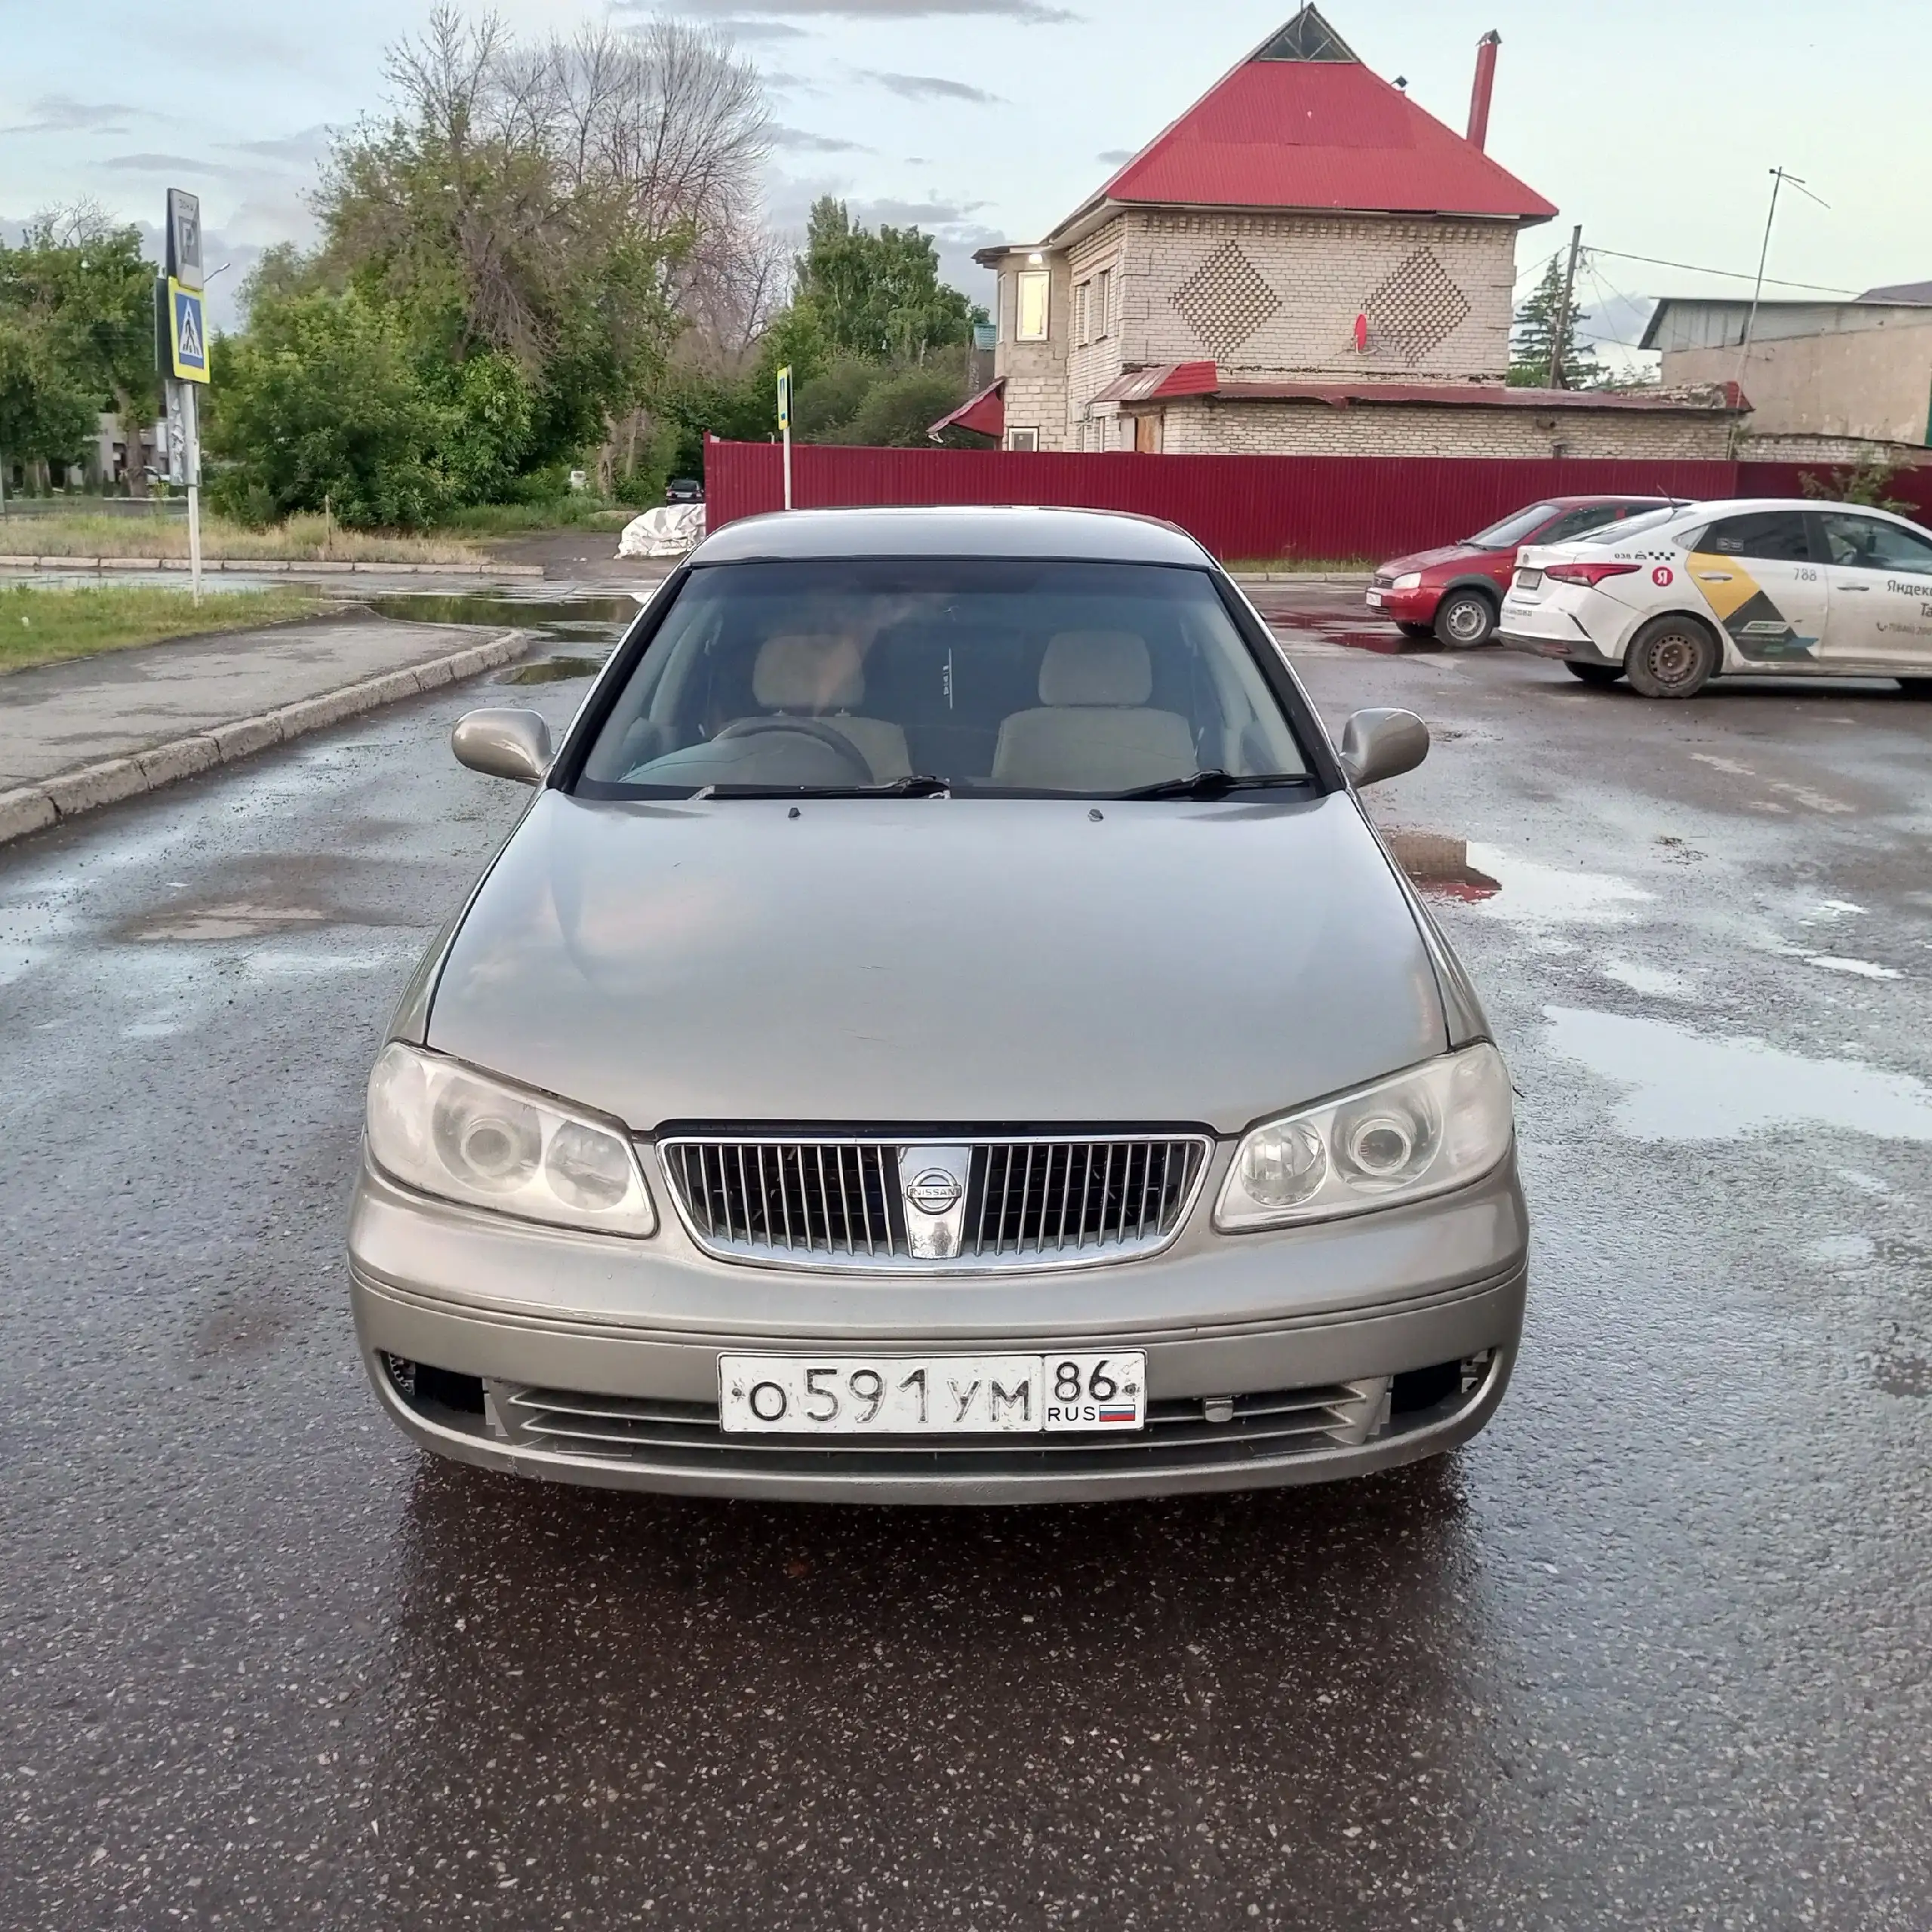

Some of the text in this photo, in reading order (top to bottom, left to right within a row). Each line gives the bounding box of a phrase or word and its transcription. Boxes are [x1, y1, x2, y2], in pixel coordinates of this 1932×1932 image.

[1657, 570, 1668, 585] Я
[1793, 568, 1817, 582] 788
[1054, 1360, 1116, 1402] 86
[1048, 1406, 1096, 1422] RUS
